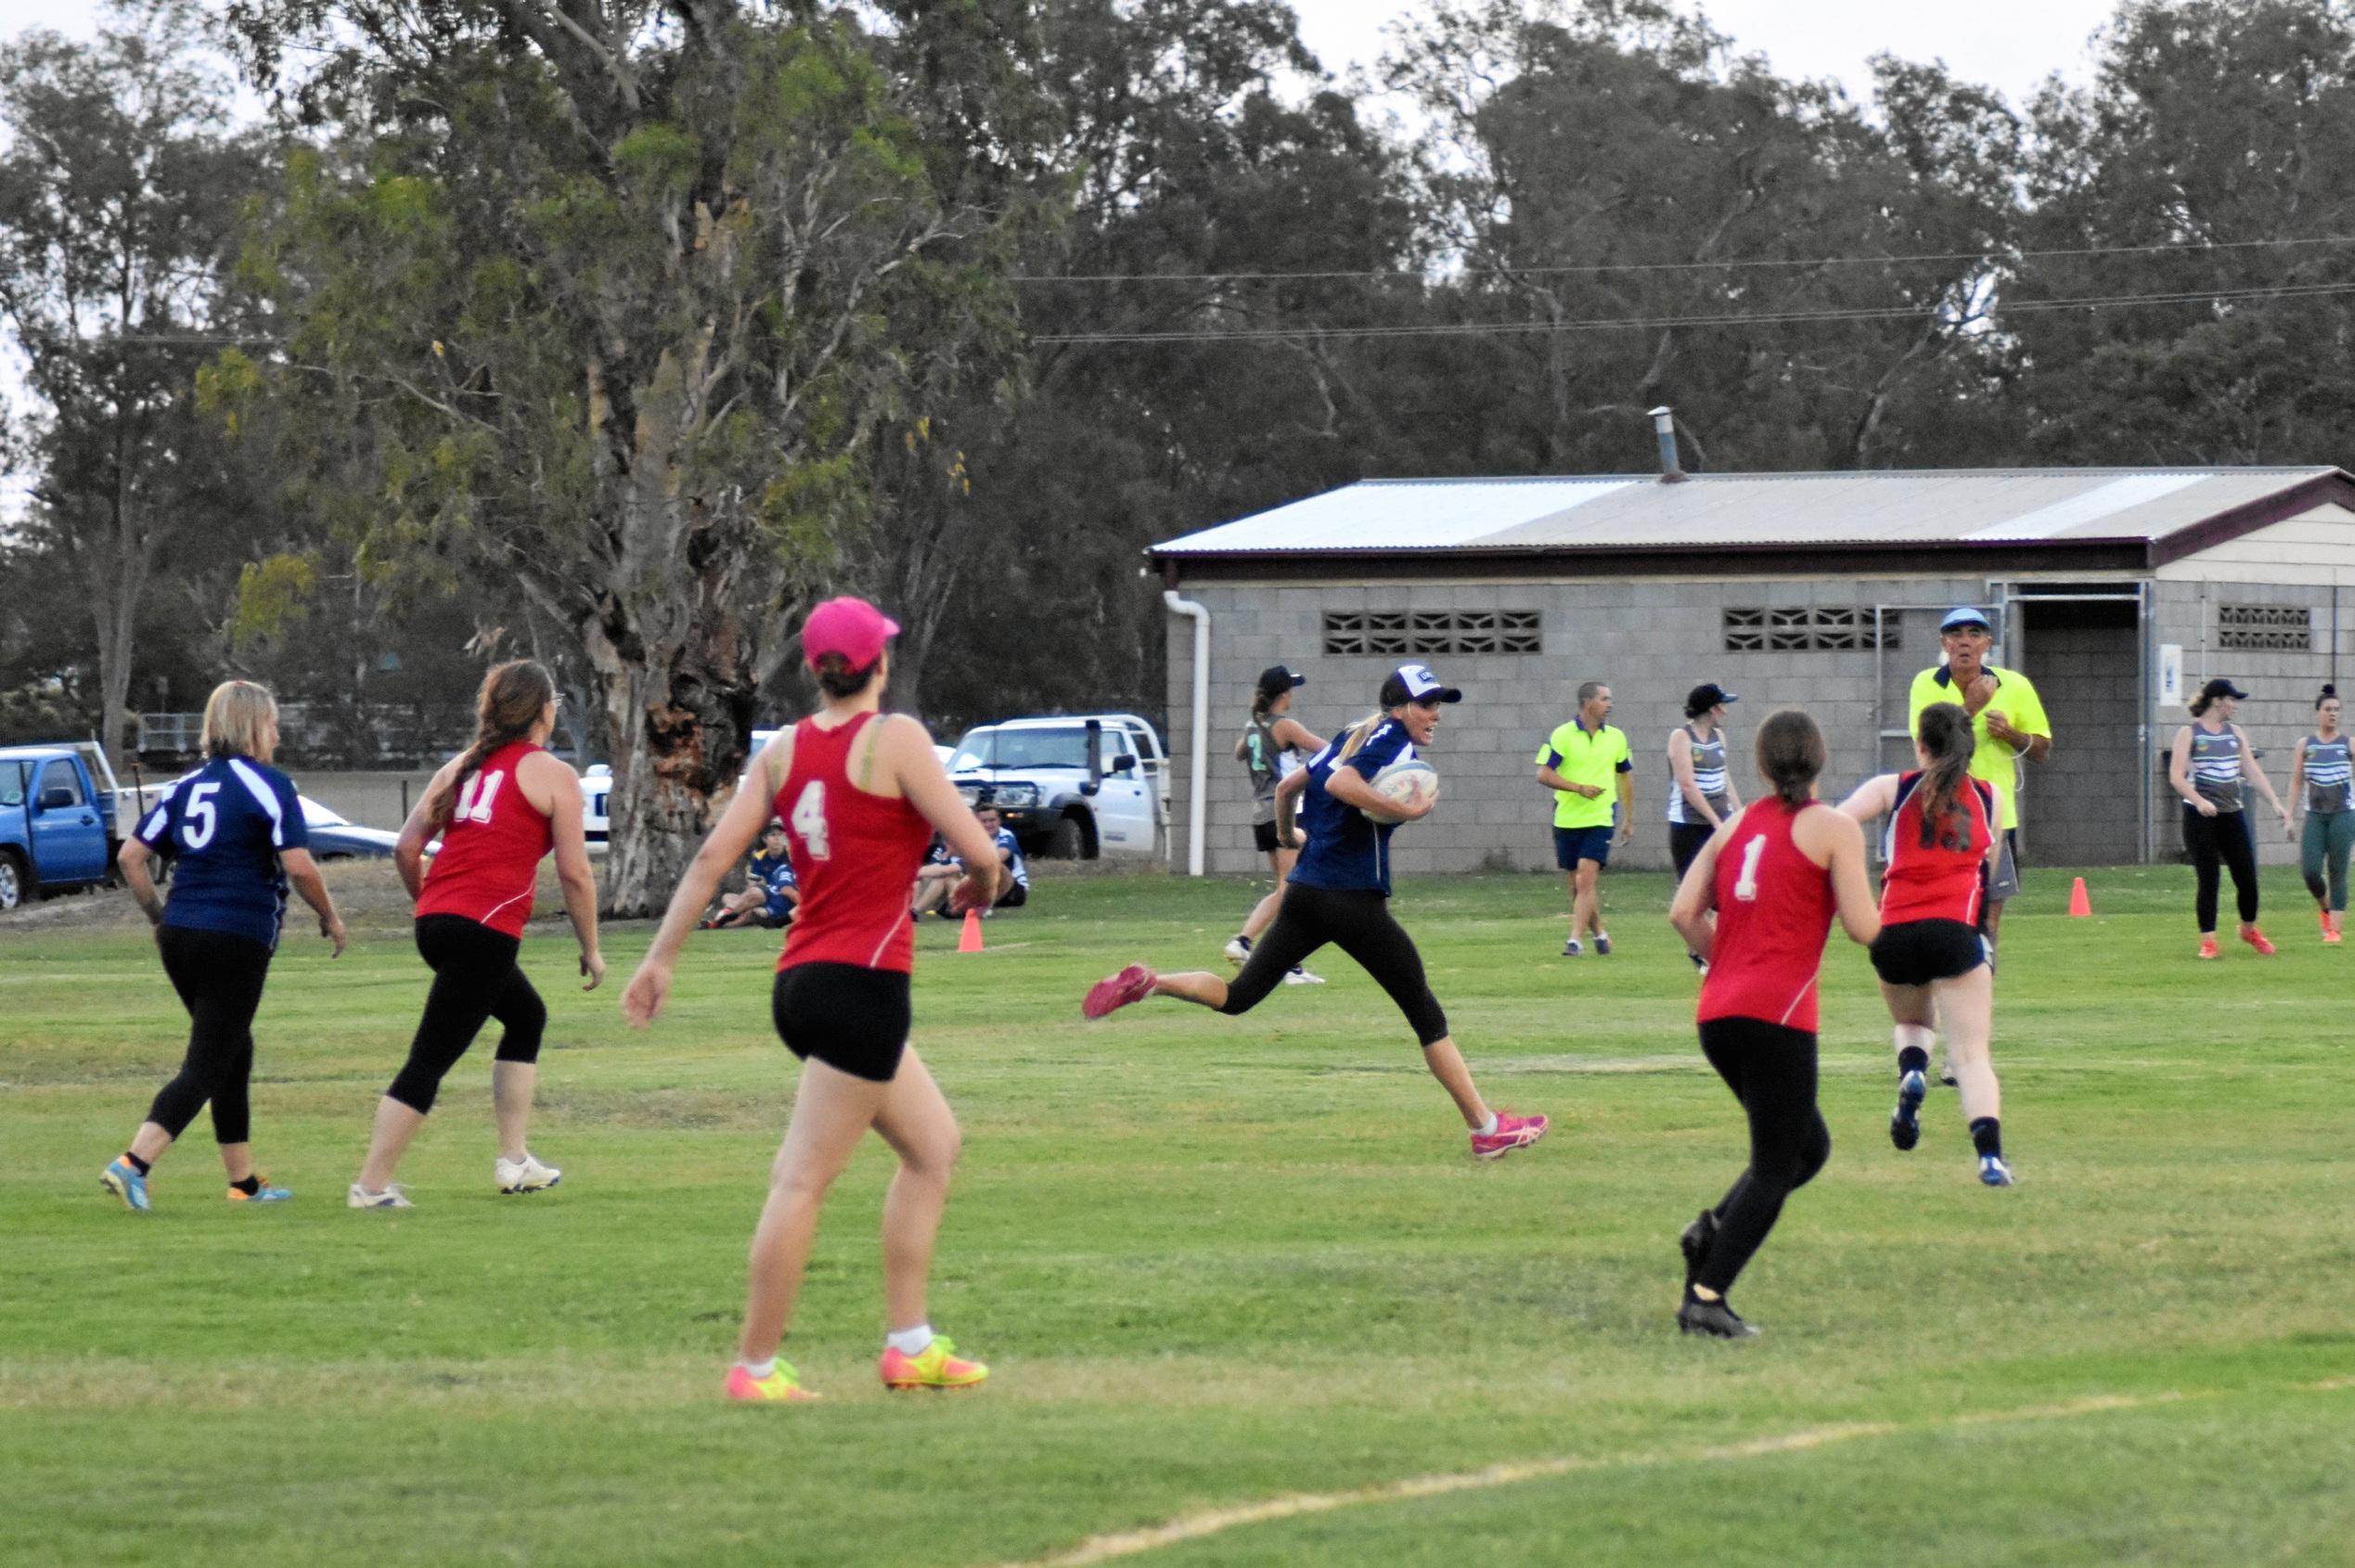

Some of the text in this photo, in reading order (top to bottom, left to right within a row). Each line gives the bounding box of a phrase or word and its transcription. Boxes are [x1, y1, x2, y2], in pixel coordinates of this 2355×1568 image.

[183, 781, 222, 849] 5
[454, 769, 504, 824] 11
[791, 779, 830, 861] 4
[1734, 833, 1768, 901] 1
